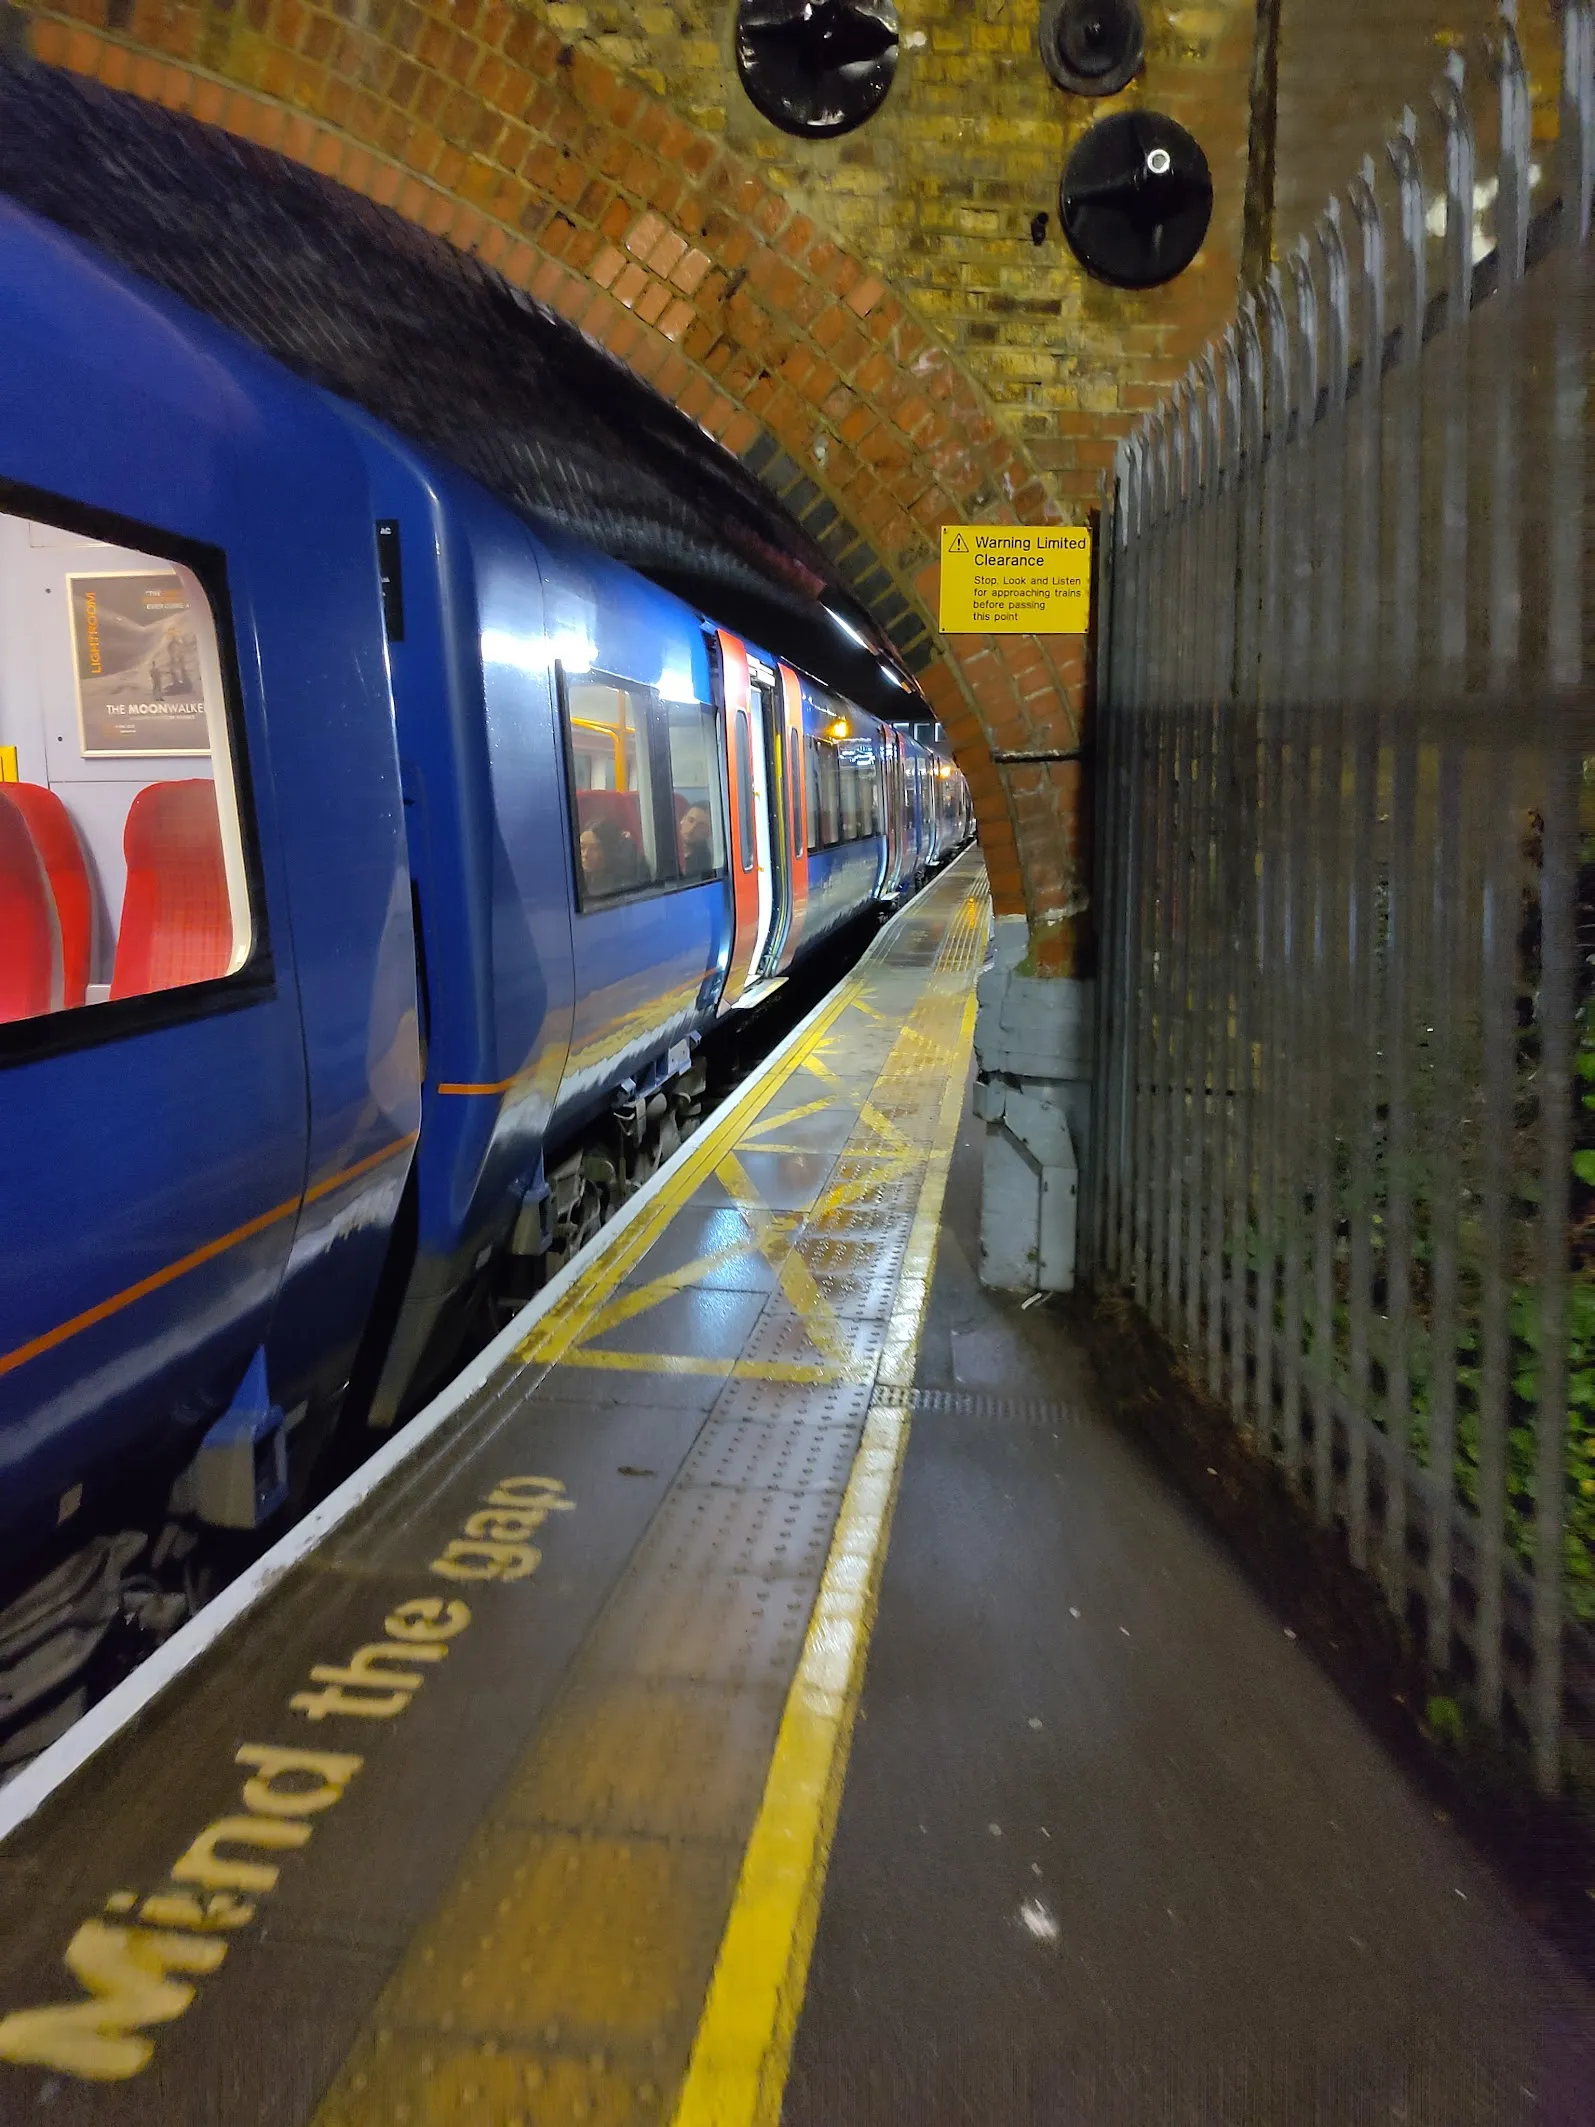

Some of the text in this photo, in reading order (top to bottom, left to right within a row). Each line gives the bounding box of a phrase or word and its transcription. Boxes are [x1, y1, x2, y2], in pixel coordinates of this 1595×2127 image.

[975, 536, 1086, 551] Warning Limited
[974, 554, 1045, 567] Clearance
[1003, 576, 1027, 585] Look
[1030, 577, 1049, 585] and
[1052, 577, 1081, 586] Listen
[974, 588, 1081, 598] for approaching trains
[973, 600, 1046, 610] before passing
[973, 612, 1019, 622] this point
[106, 704, 126, 715] THE
[0, 1476, 576, 2082] Mind the gap
